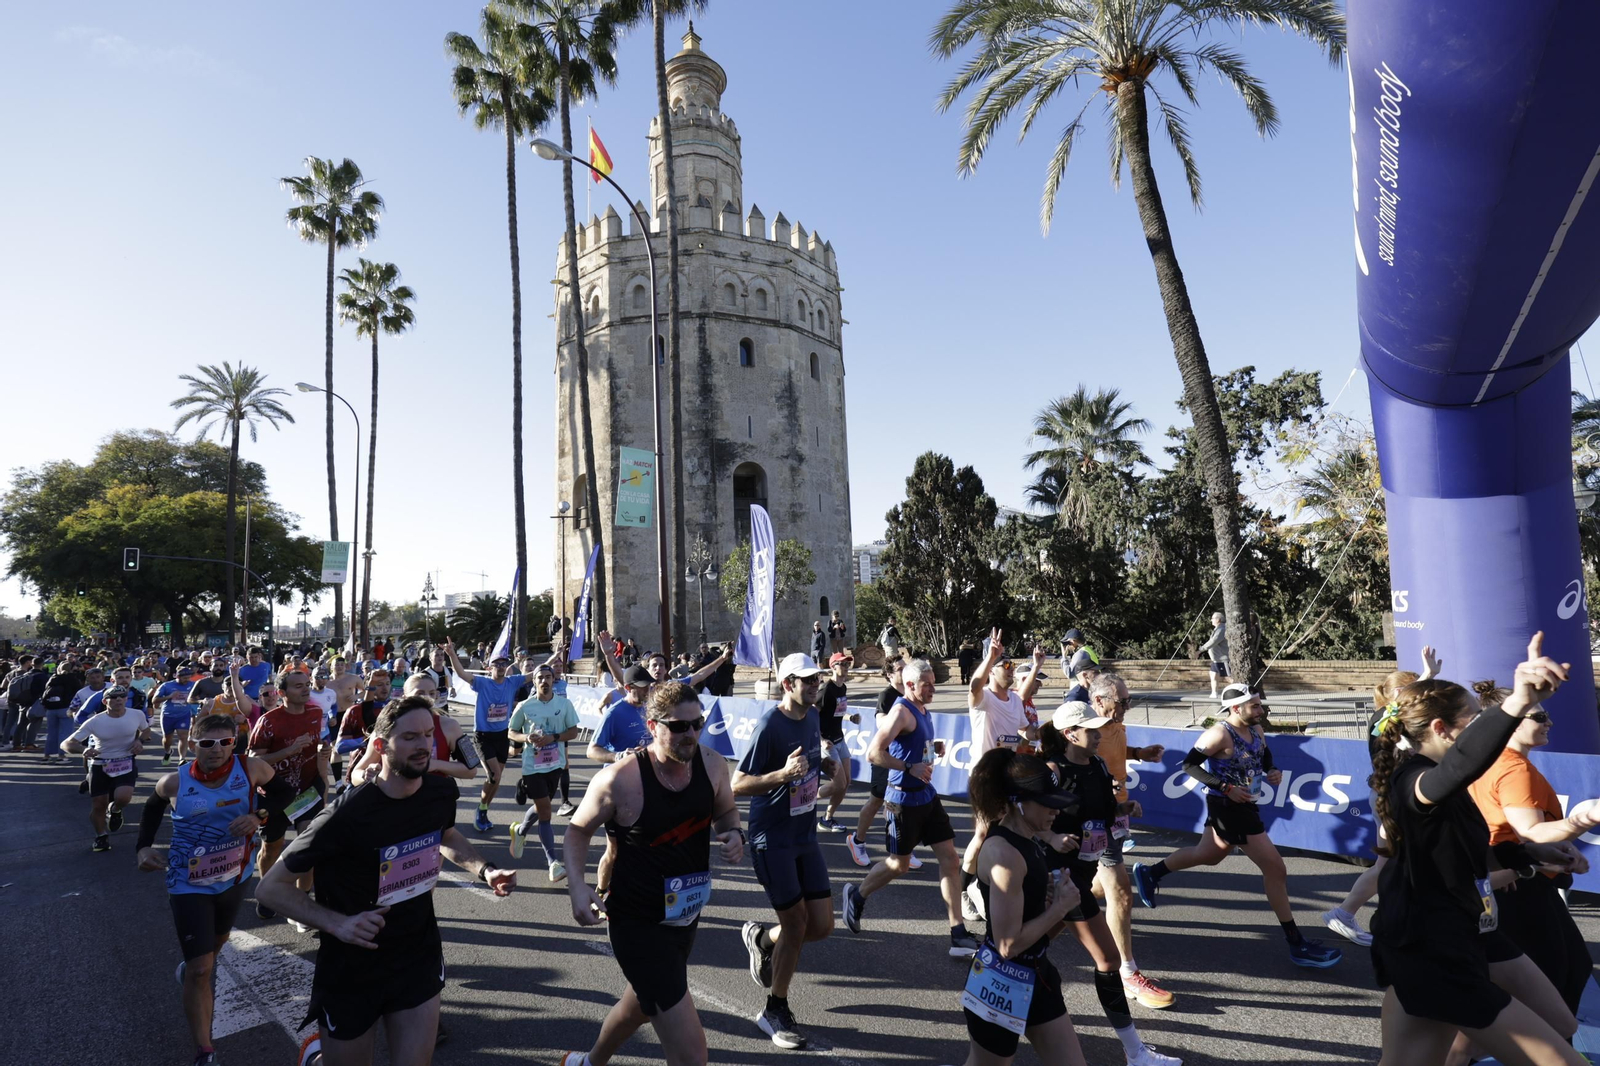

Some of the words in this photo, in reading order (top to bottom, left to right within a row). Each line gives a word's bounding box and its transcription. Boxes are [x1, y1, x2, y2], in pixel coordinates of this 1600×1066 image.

[1374, 60, 1412, 133] body
[1374, 116, 1400, 189] sound
[637, 491, 650, 499] CASA
[1407, 620, 1425, 631] body
[209, 839, 240, 853] ZURICH
[402, 836, 435, 854] ZURICH
[402, 858, 420, 870] 8303
[379, 866, 440, 895] FERIANTEFRANCE
[686, 892, 701, 903] 6831
[995, 959, 1030, 981] ZURICH
[991, 978, 1010, 995] 7574
[980, 986, 1013, 1014] DORA
